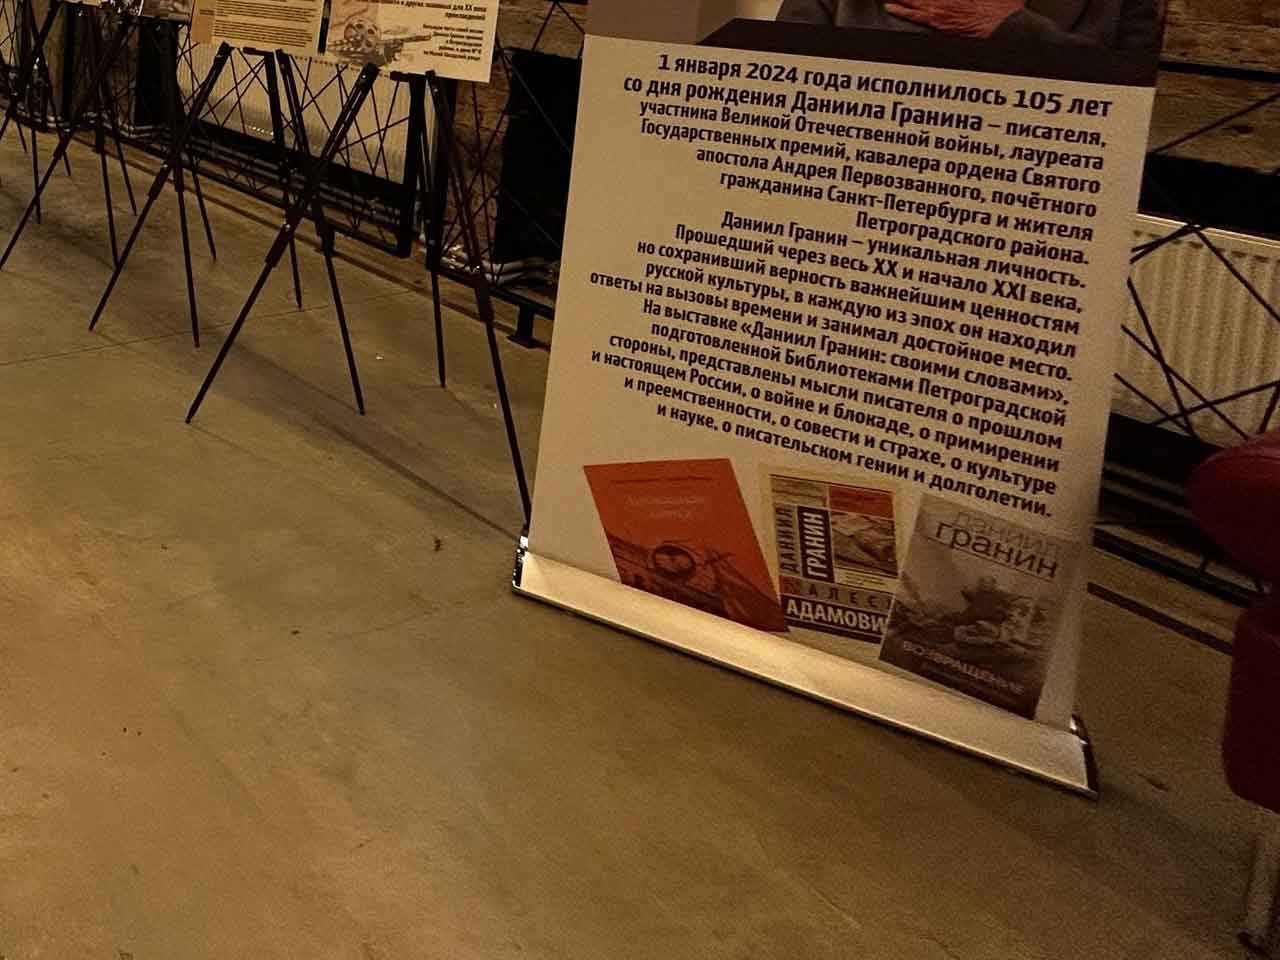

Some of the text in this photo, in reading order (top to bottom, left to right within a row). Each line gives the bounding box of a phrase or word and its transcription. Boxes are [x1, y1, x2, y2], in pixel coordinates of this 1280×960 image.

[624, 77, 643, 92] со
[646, 80, 682, 98] дня
[685, 83, 787, 109] рождения
[790, 90, 886, 120] Даниила
[890, 101, 983, 132] Гранина
[1005, 122, 1107, 148] писателя,
[658, 54, 1113, 117] 1 января 2024 года исполнилось 105 лет
[639, 101, 1104, 170] участника Великой Отечественной войны, лауреата
[641, 117, 1101, 194] Государственных премий, кавалера ордена Святого
[696, 149, 1097, 218] апостола Андрея Первозванного, почётного
[720, 172, 1094, 242] гражданина Санкт-Петербурга и жителя
[675, 223, 1083, 314] Прошедший через весь XX и начало XXI века,
[720, 211, 784, 236] Даниил
[788, 221, 848, 247] Гранин
[867, 238, 980, 270] уникальная
[983, 259, 1086, 289] личность.
[855, 210, 1090, 265] Петроградского района.
[590, 272, 1072, 382] ответы на вызовы времени и занимал достойное место.
[637, 241, 1080, 335] но сохранивший верность важнейшим ценностям
[645, 263, 1076, 358] русской культуры, в каждую из эпох он находил
[643, 298, 661, 316] На
[664, 306, 738, 332] выставке
[740, 320, 816, 349] «Даниил
[819, 334, 887, 364] Гранин:
[890, 353, 960, 380] своими
[651, 323, 1067, 427] подготовленной Библиотеками Петроградской
[592, 350, 1060, 473] и настоящем России, о войне и блокаде, о примирении
[609, 335, 1063, 450] стороны, представлены мысли писателя о прошлом
[624, 377, 1057, 495] и преемственности, о совести и страхе, о культуре
[657, 403, 1052, 518] и науке, о писательском гении и долголетии.
[802, 511, 829, 578] ГРАНИН
[935, 522, 1059, 579] гранин
[786, 598, 889, 632] АДАМОВИ
